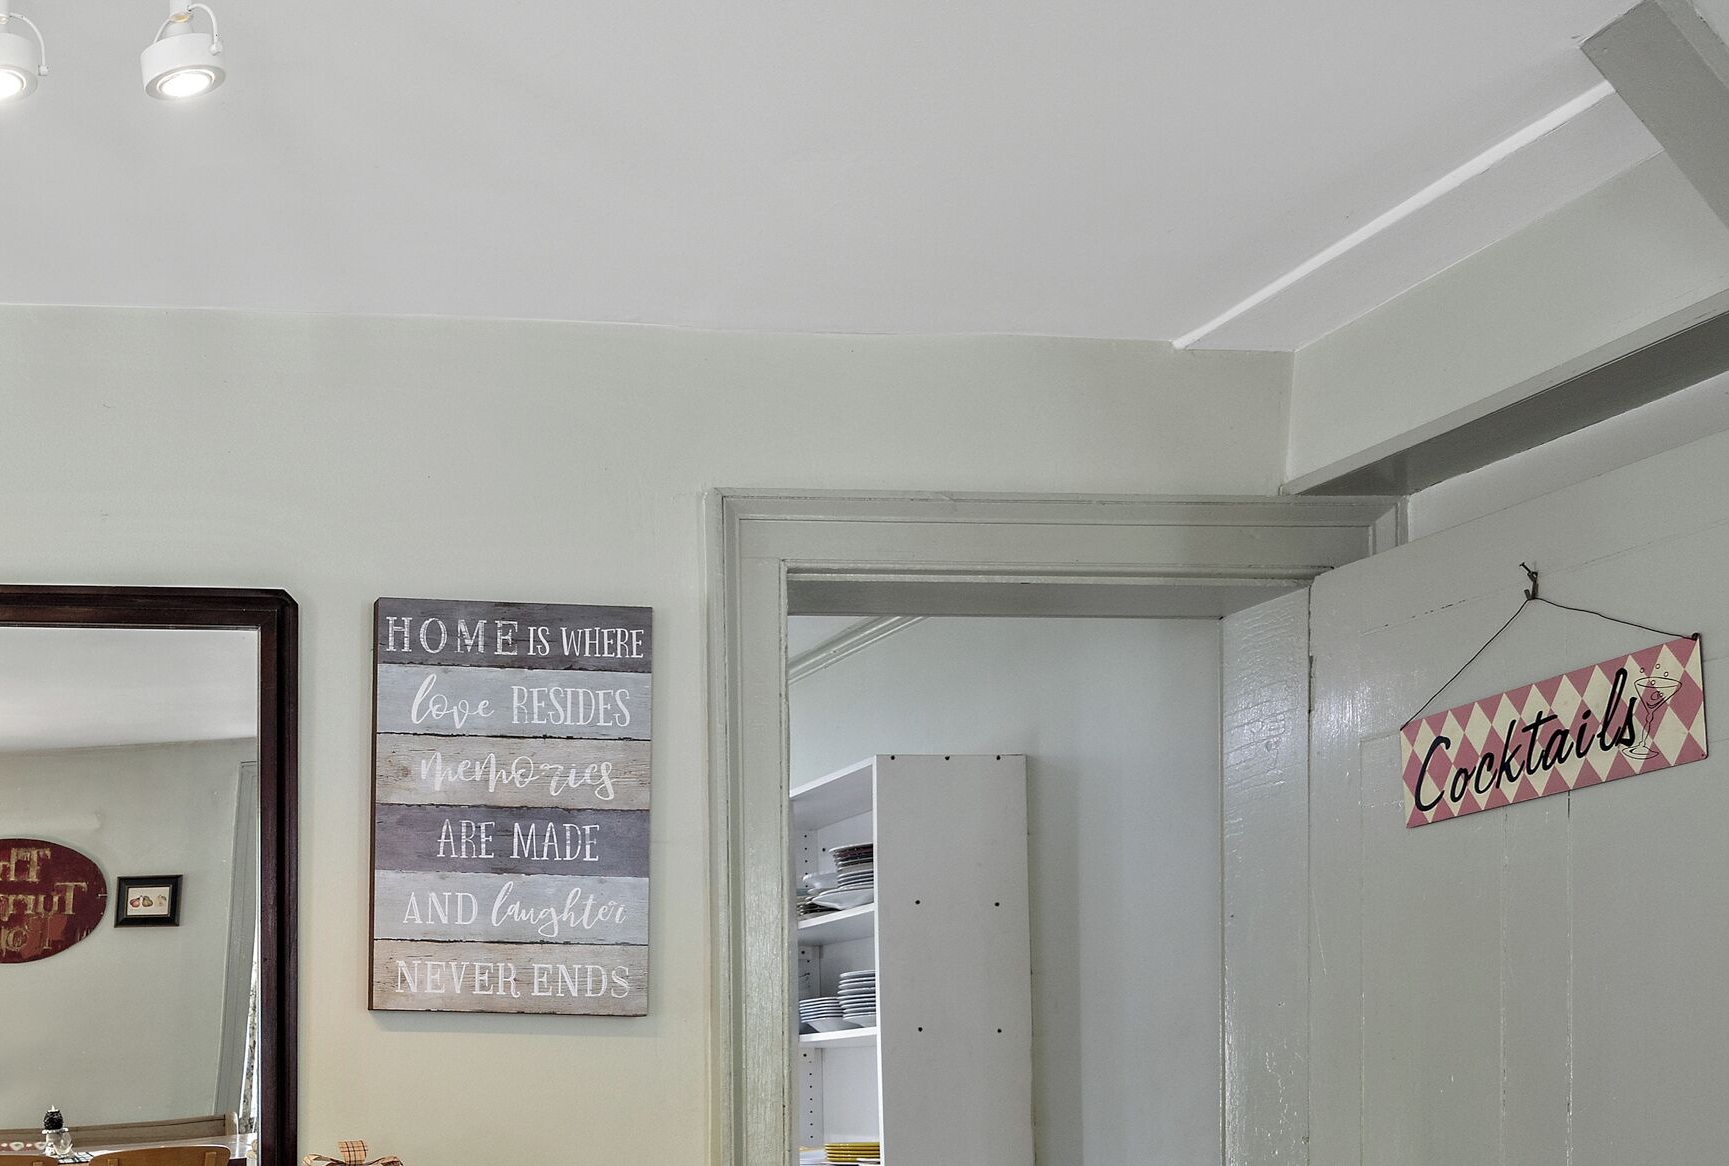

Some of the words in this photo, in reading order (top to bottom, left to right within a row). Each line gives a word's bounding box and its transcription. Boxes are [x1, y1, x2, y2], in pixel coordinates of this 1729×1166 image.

[386, 616, 518, 656] HOME
[527, 626, 550, 656] IS
[560, 627, 644, 658] WHERE
[411, 674, 495, 729] love
[511, 686, 631, 727] RESIDES
[1414, 667, 1637, 812] Cocktails
[421, 752, 615, 800] memories
[437, 819, 495, 859] ARE
[510, 822, 600, 861] MADE
[403, 892, 478, 925] AND
[491, 881, 626, 937] laughter
[396, 960, 520, 998] NEVER
[531, 964, 629, 998] ENDS
